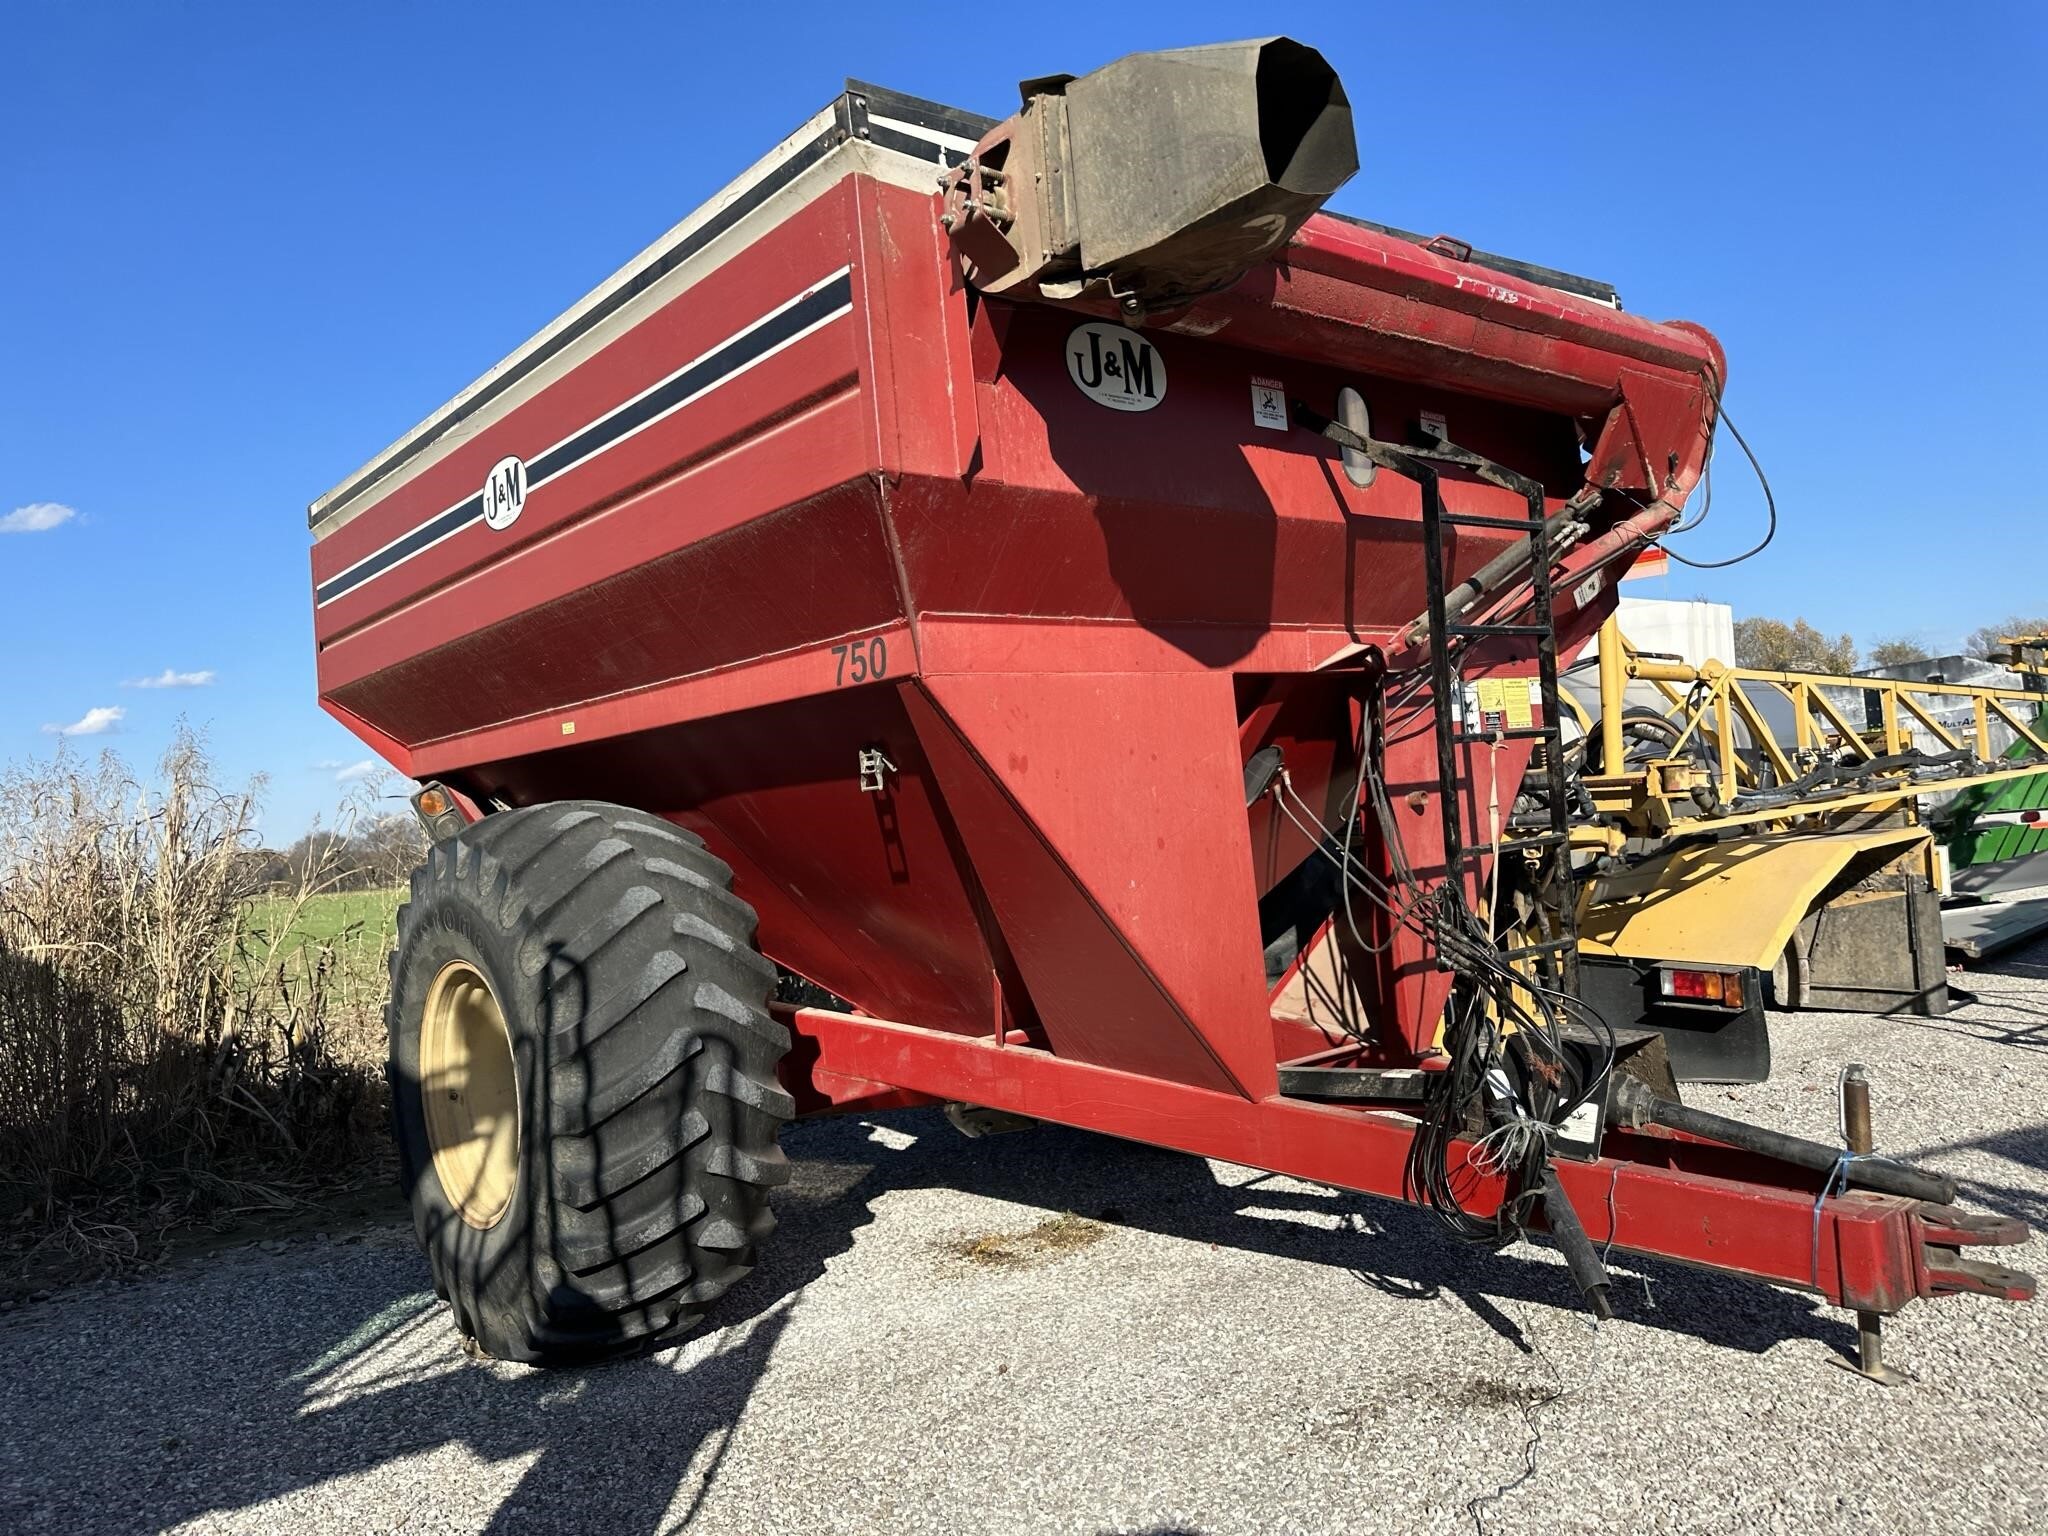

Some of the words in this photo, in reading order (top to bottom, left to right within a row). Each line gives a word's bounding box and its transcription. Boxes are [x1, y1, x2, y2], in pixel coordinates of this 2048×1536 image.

[1074, 331, 1157, 399] J&M
[1257, 377, 1284, 390] DANGER
[486, 461, 522, 520] J&M
[831, 637, 887, 686] 750
